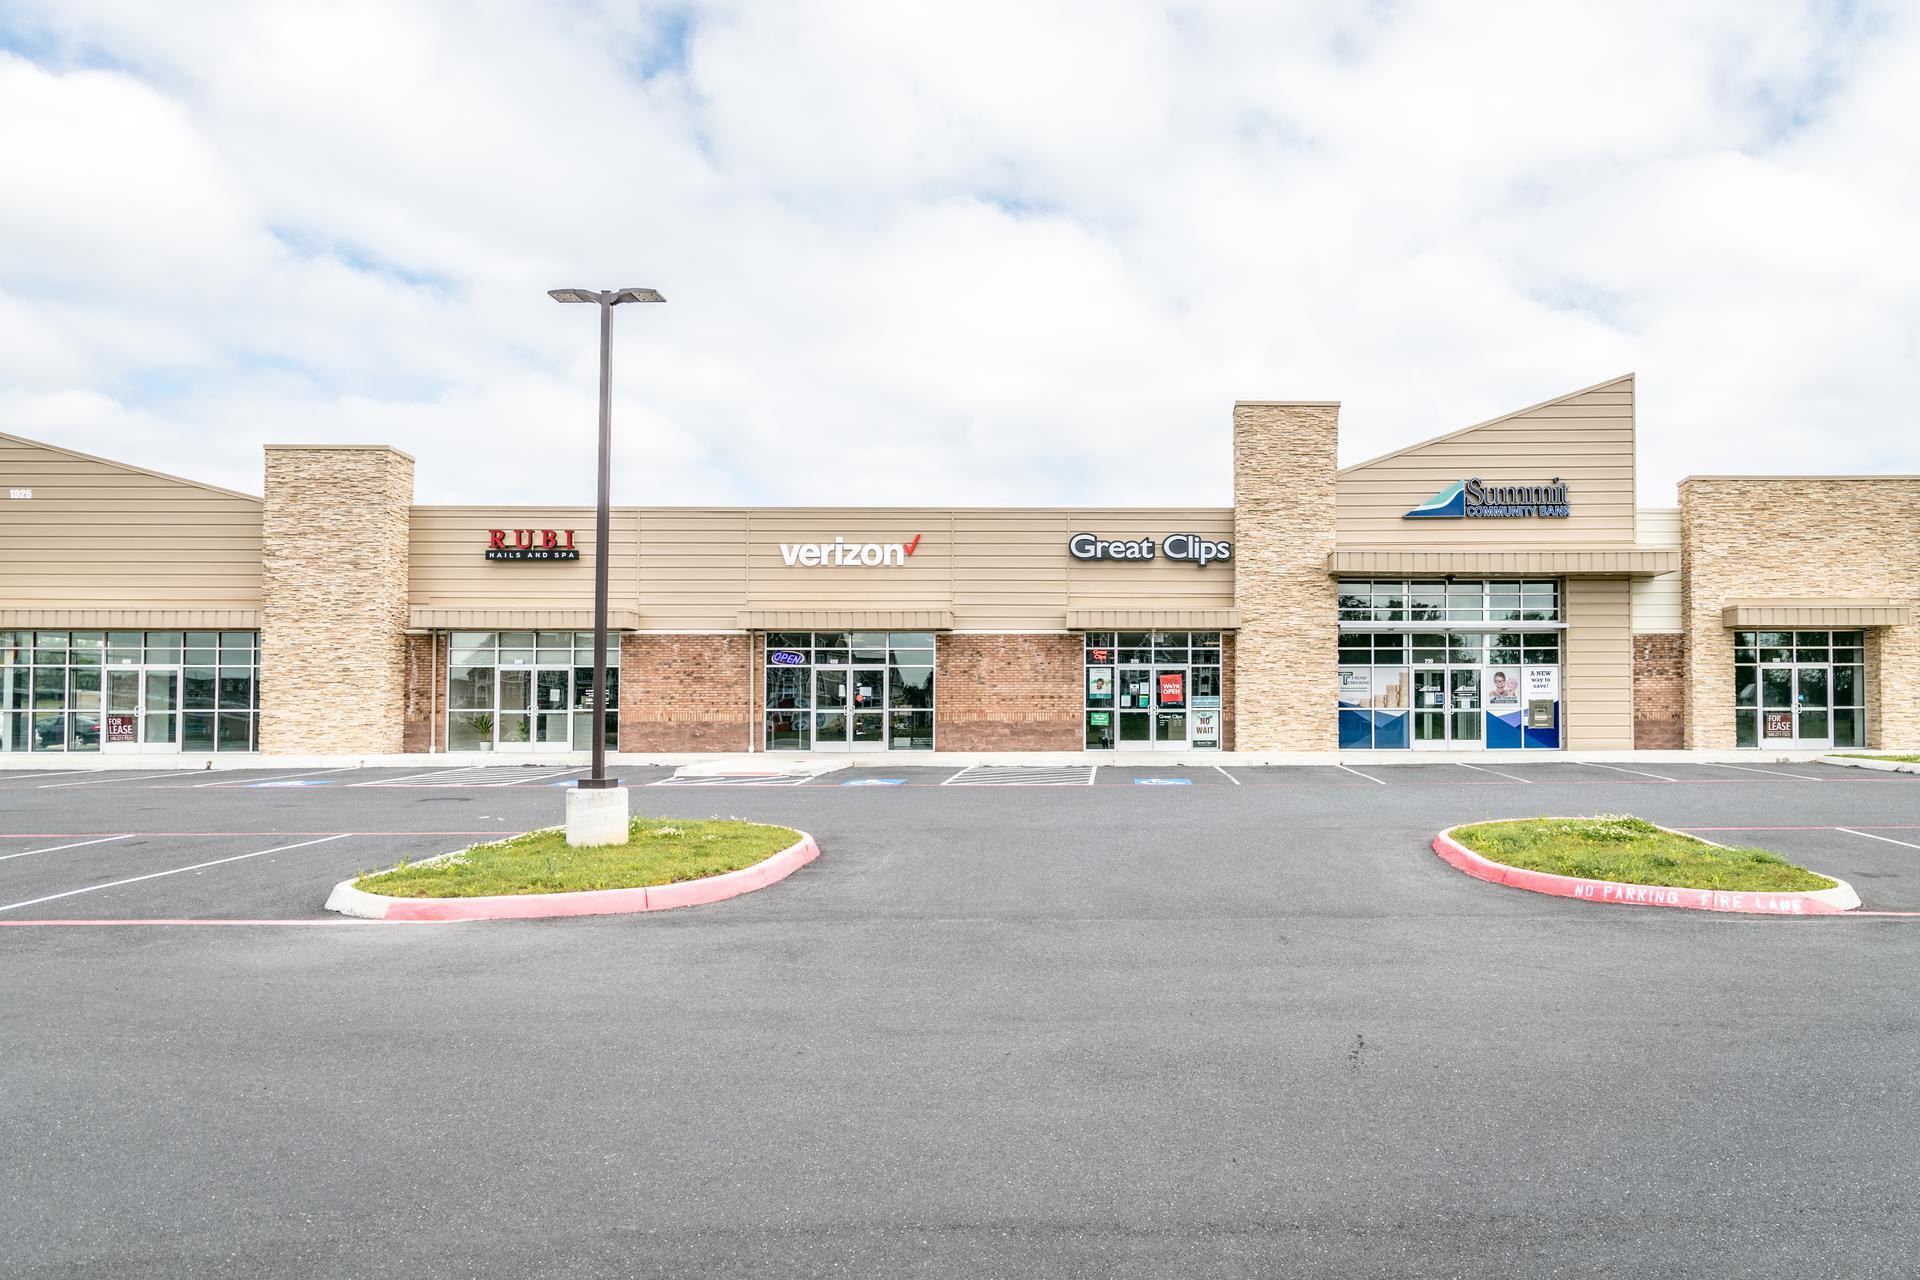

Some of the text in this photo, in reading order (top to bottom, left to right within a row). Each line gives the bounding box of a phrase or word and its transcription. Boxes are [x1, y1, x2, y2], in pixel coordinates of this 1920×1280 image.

[1466, 477, 1568, 506] Summit
[1467, 505, 1569, 517] COMMUNITY BANK
[488, 529, 576, 549] RUBI
[779, 536, 905, 566] verizon
[1070, 534, 1230, 565] Great Clips
[773, 652, 802, 664] OPEN
[109, 725, 133, 734] LEASE
[1768, 722, 1791, 730] LEASE
[1575, 884, 1803, 913] NO PARKING FIRE LANE
